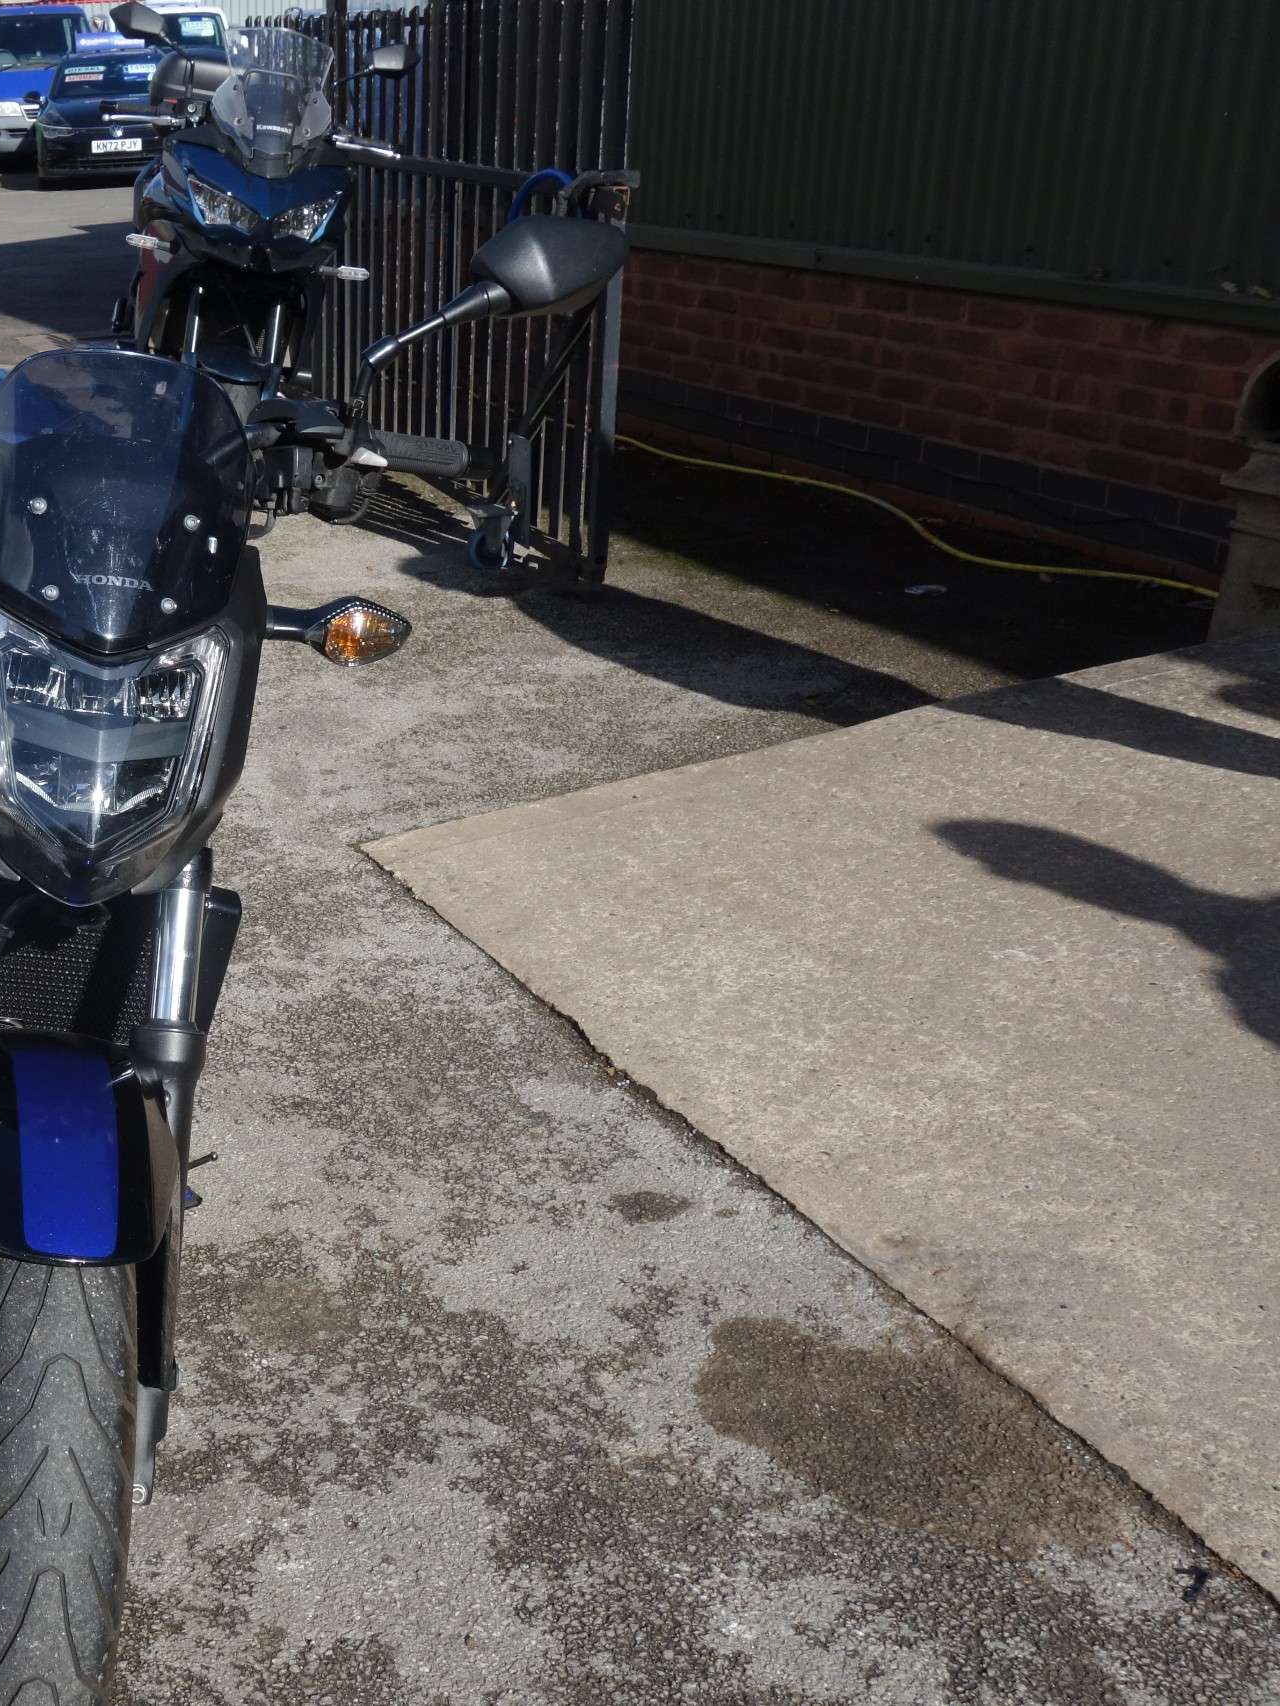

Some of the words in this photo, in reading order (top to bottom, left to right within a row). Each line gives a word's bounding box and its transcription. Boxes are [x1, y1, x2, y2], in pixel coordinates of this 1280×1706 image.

[96, 141, 118, 151] KN72
[121, 140, 138, 150] PJY
[75, 574, 153, 591] HONDA
